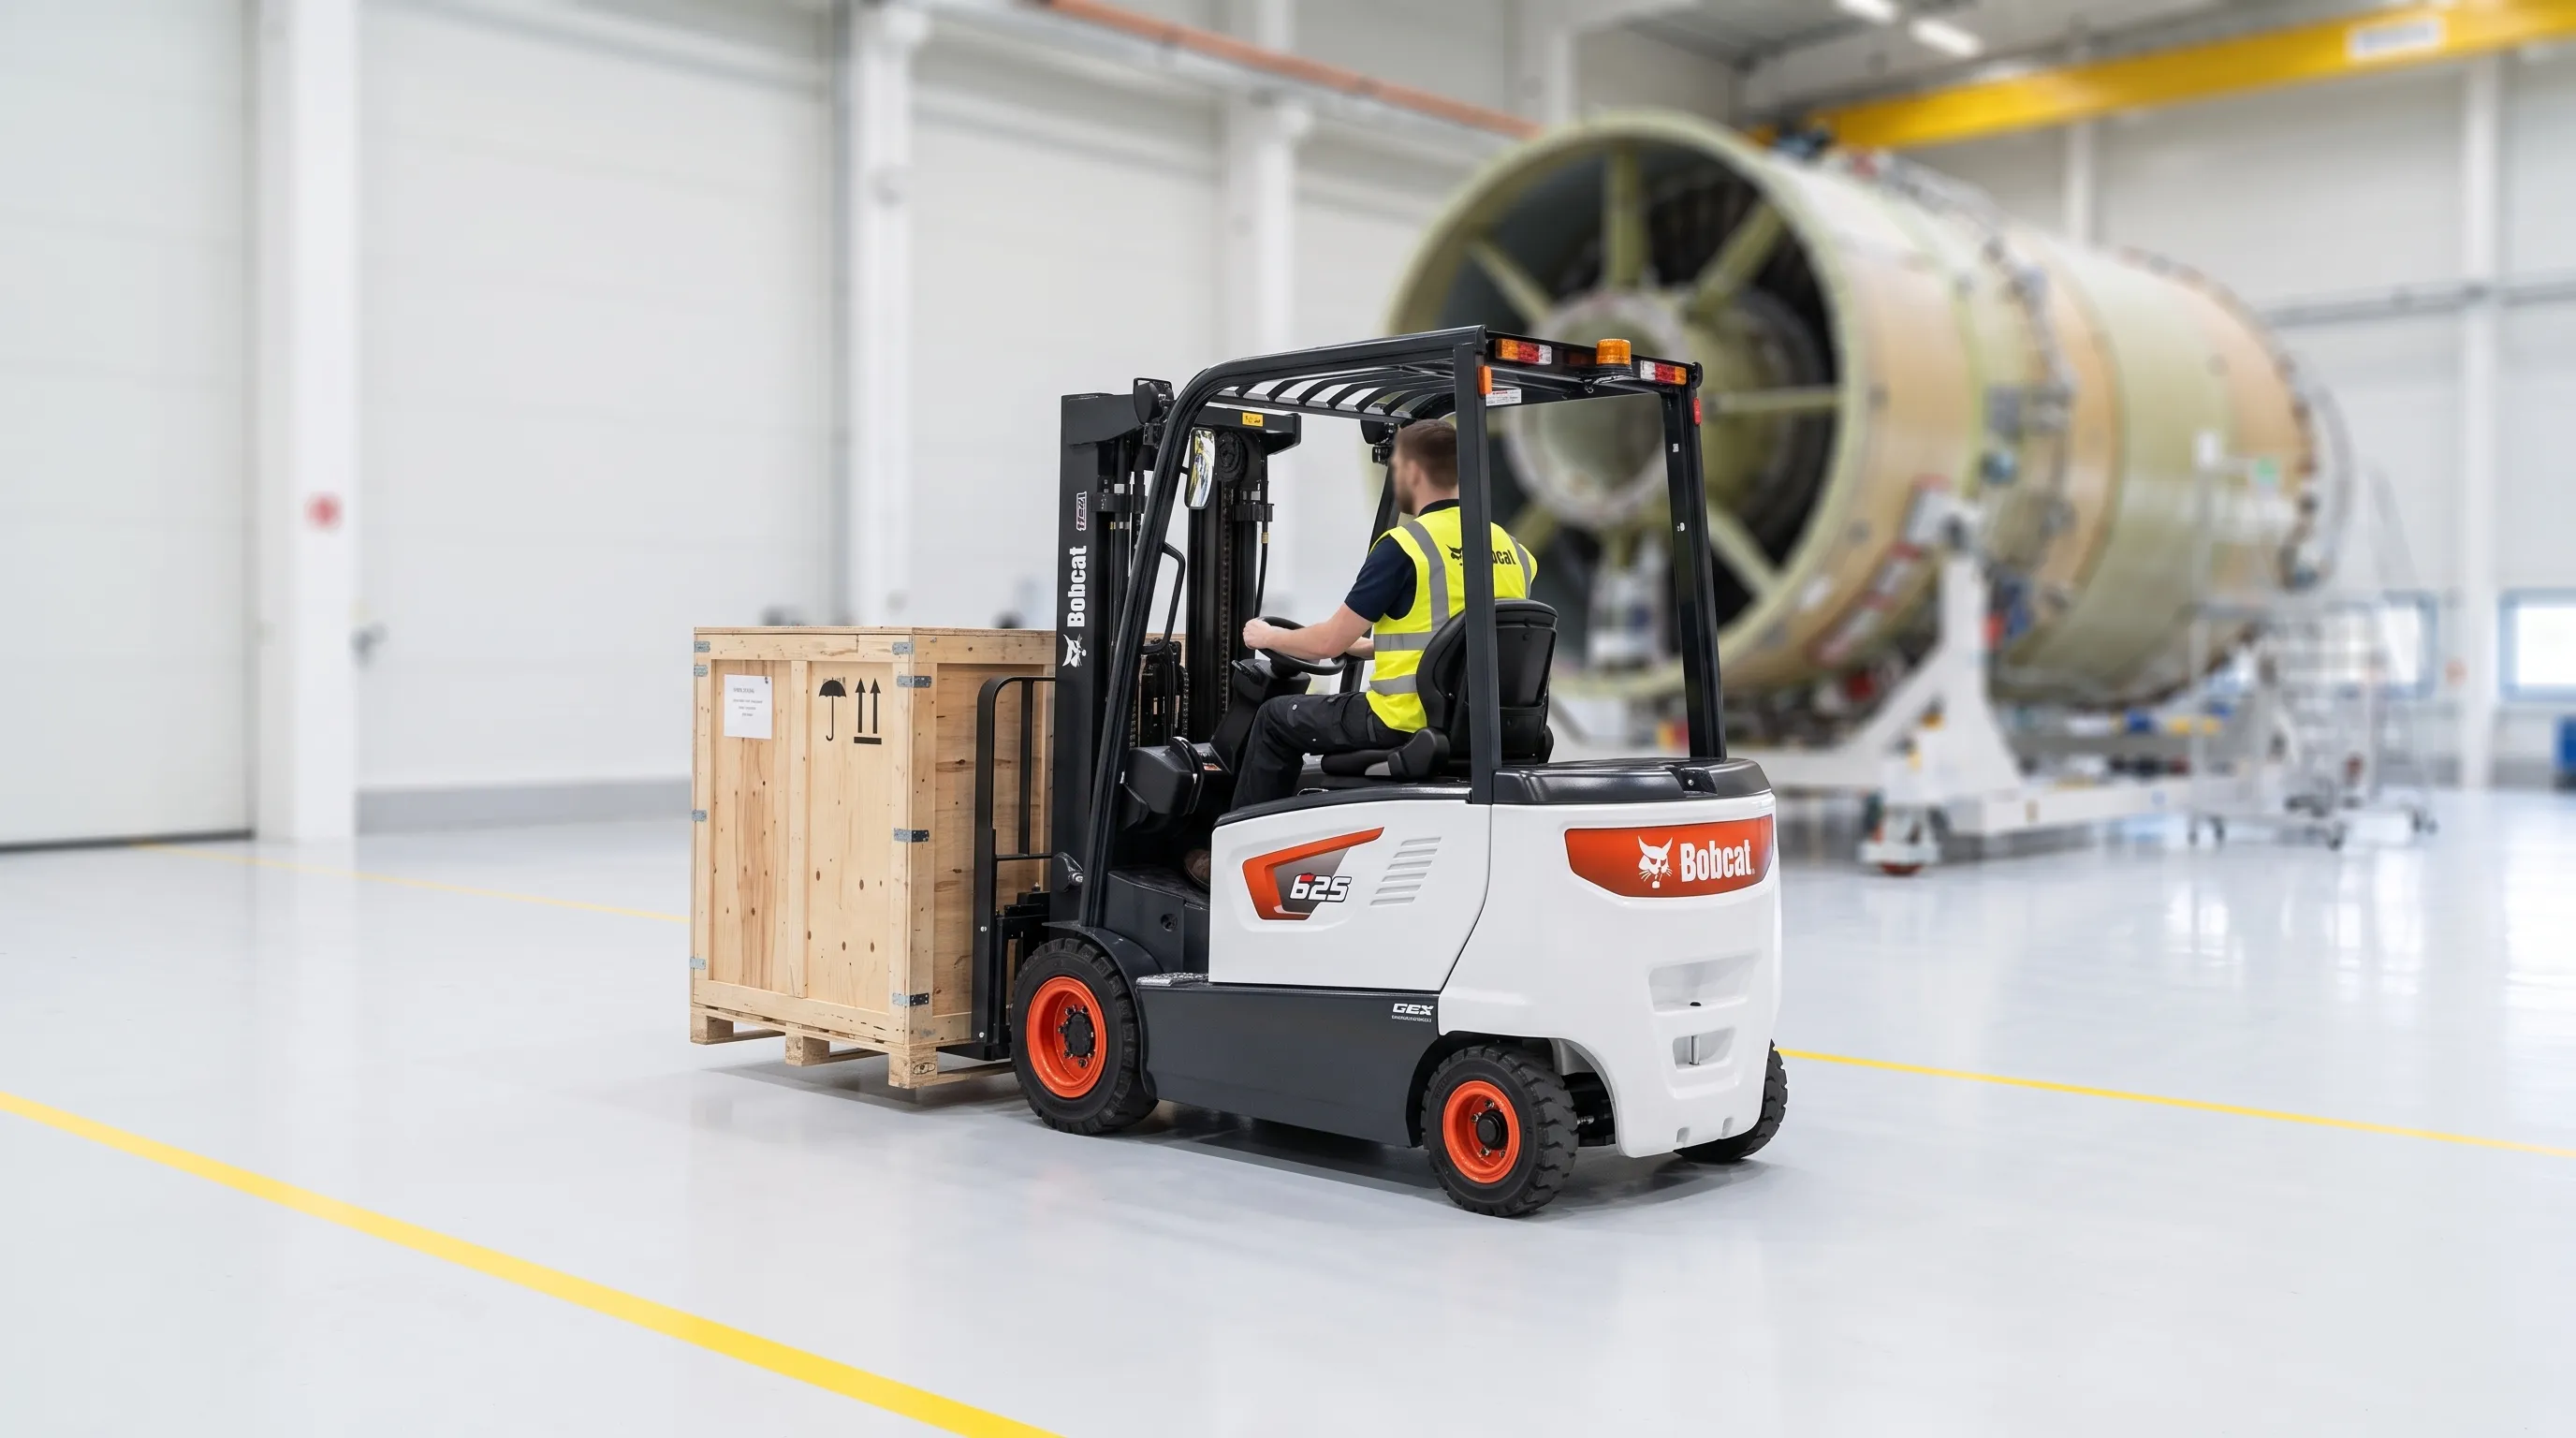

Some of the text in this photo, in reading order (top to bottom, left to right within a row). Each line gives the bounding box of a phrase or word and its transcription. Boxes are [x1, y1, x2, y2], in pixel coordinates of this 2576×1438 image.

[1067, 545, 1087, 627] Bobcat
[1680, 839, 1752, 882] Bobcat
[1289, 873, 1352, 902] 625
[1392, 1003, 1434, 1016] GEX
